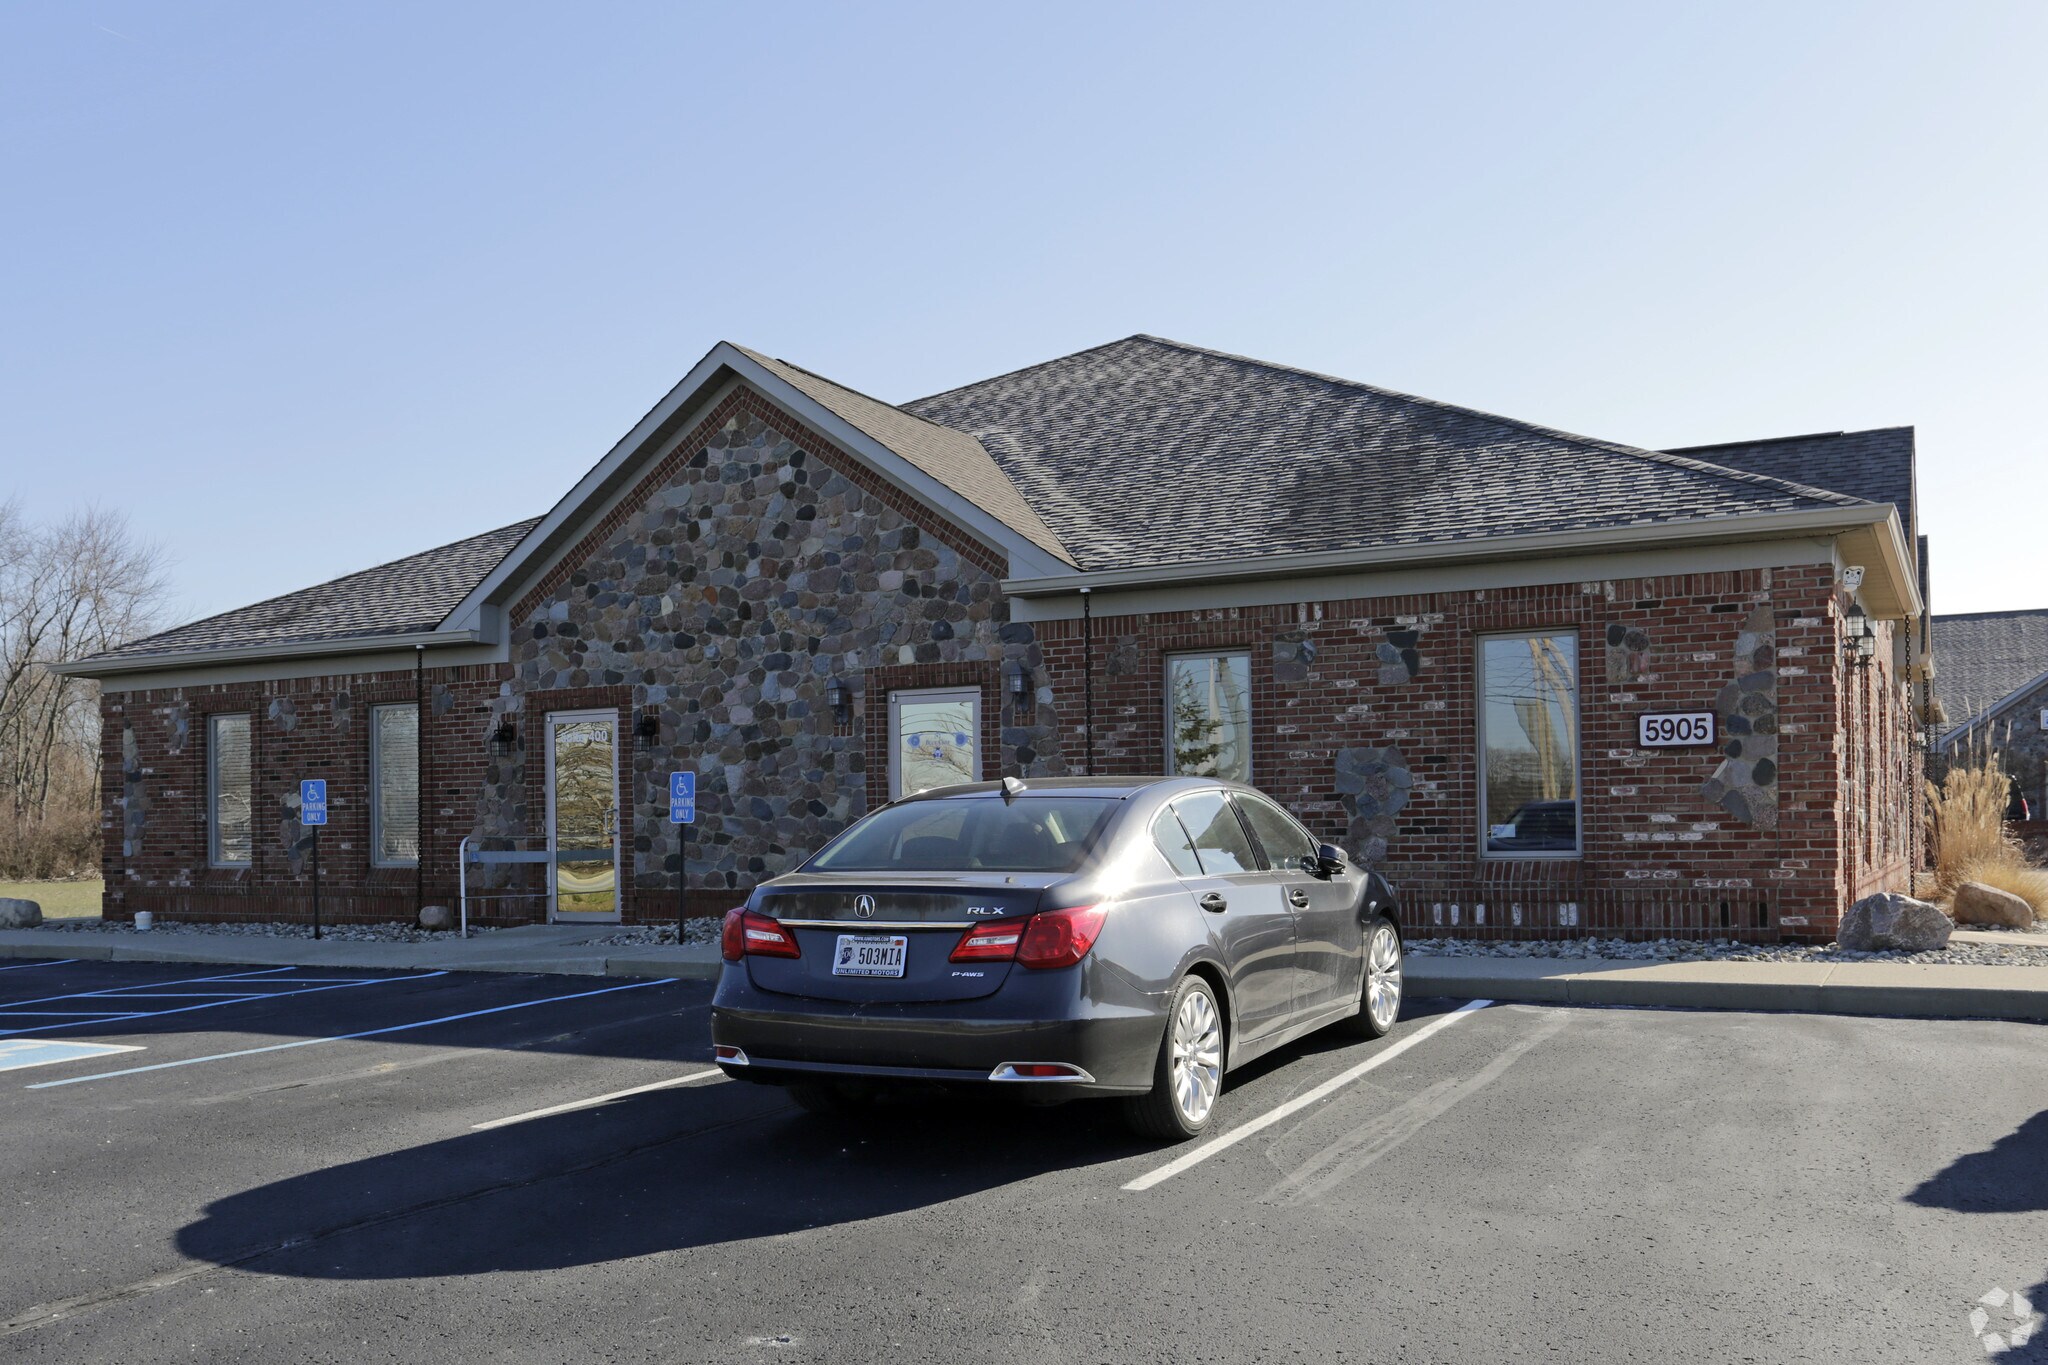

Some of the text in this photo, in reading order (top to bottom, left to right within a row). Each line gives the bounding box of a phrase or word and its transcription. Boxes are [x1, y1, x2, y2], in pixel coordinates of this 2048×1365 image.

[1645, 718, 1708, 742] 5905
[588, 730, 608, 742] 400
[302, 802, 326, 812] PARKING
[671, 797, 694, 808] PARKING
[306, 812, 321, 822] ONLY
[675, 809, 689, 819] ONLY
[966, 906, 1005, 915] RLX
[858, 947, 902, 966] 503MIA
[836, 968, 870, 976] UNLIMITED
